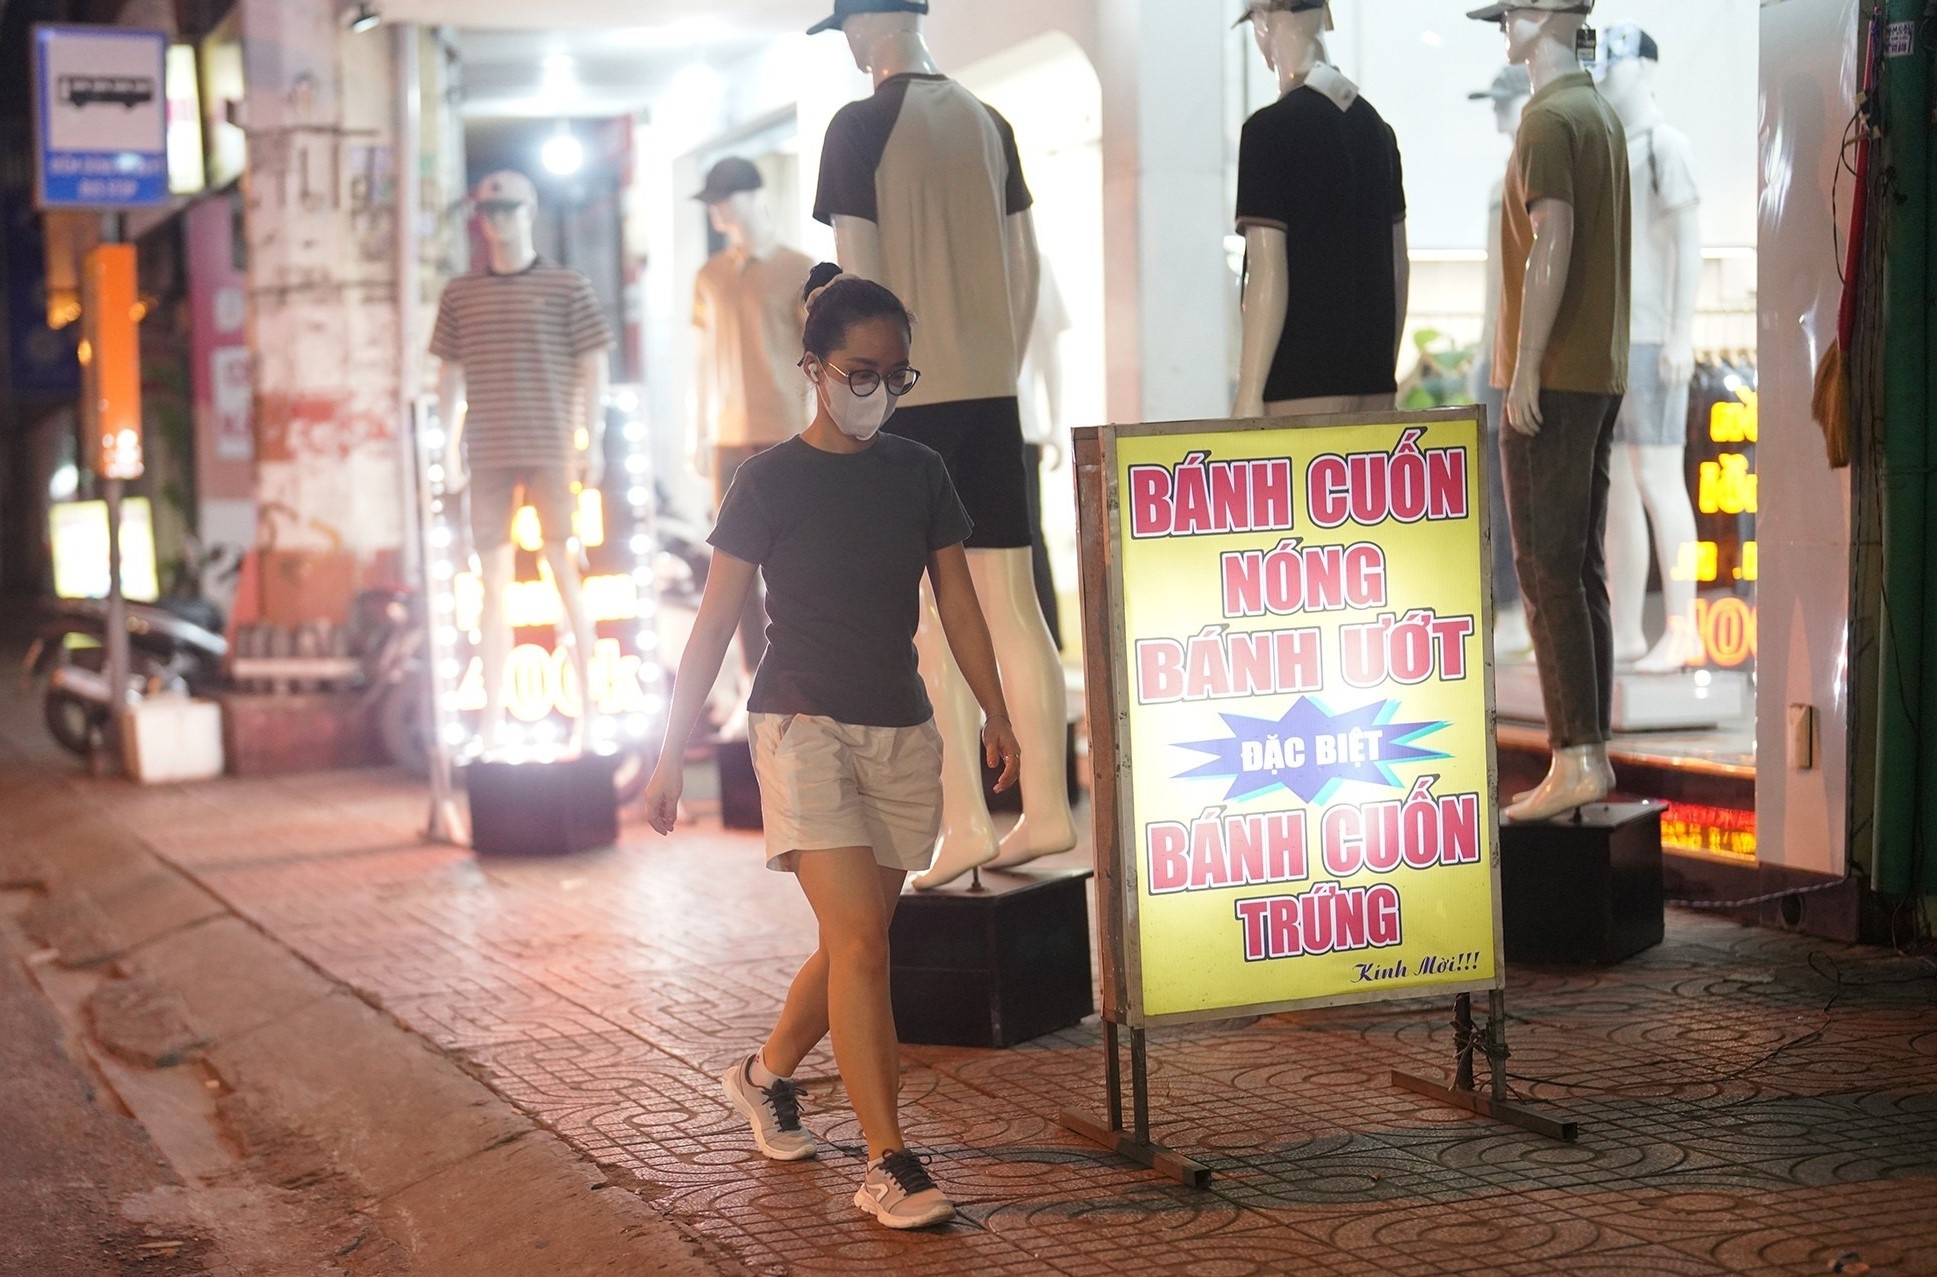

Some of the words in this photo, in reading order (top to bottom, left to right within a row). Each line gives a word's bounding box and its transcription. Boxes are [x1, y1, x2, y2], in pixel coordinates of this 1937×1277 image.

[1128, 450, 1293, 539] BÁNH
[1305, 427, 1469, 528] CUỐN
[1221, 537, 1387, 619] NÓNG
[1136, 624, 1323, 705] BÁNH
[1340, 608, 1475, 689] ƯỚT
[1241, 734, 1306, 776] ĐẶC
[1315, 726, 1383, 769] BIỆT
[1146, 805, 1309, 895] BÁNH
[1322, 774, 1480, 877] CUỐN
[1235, 882, 1402, 962] TRỨNG
